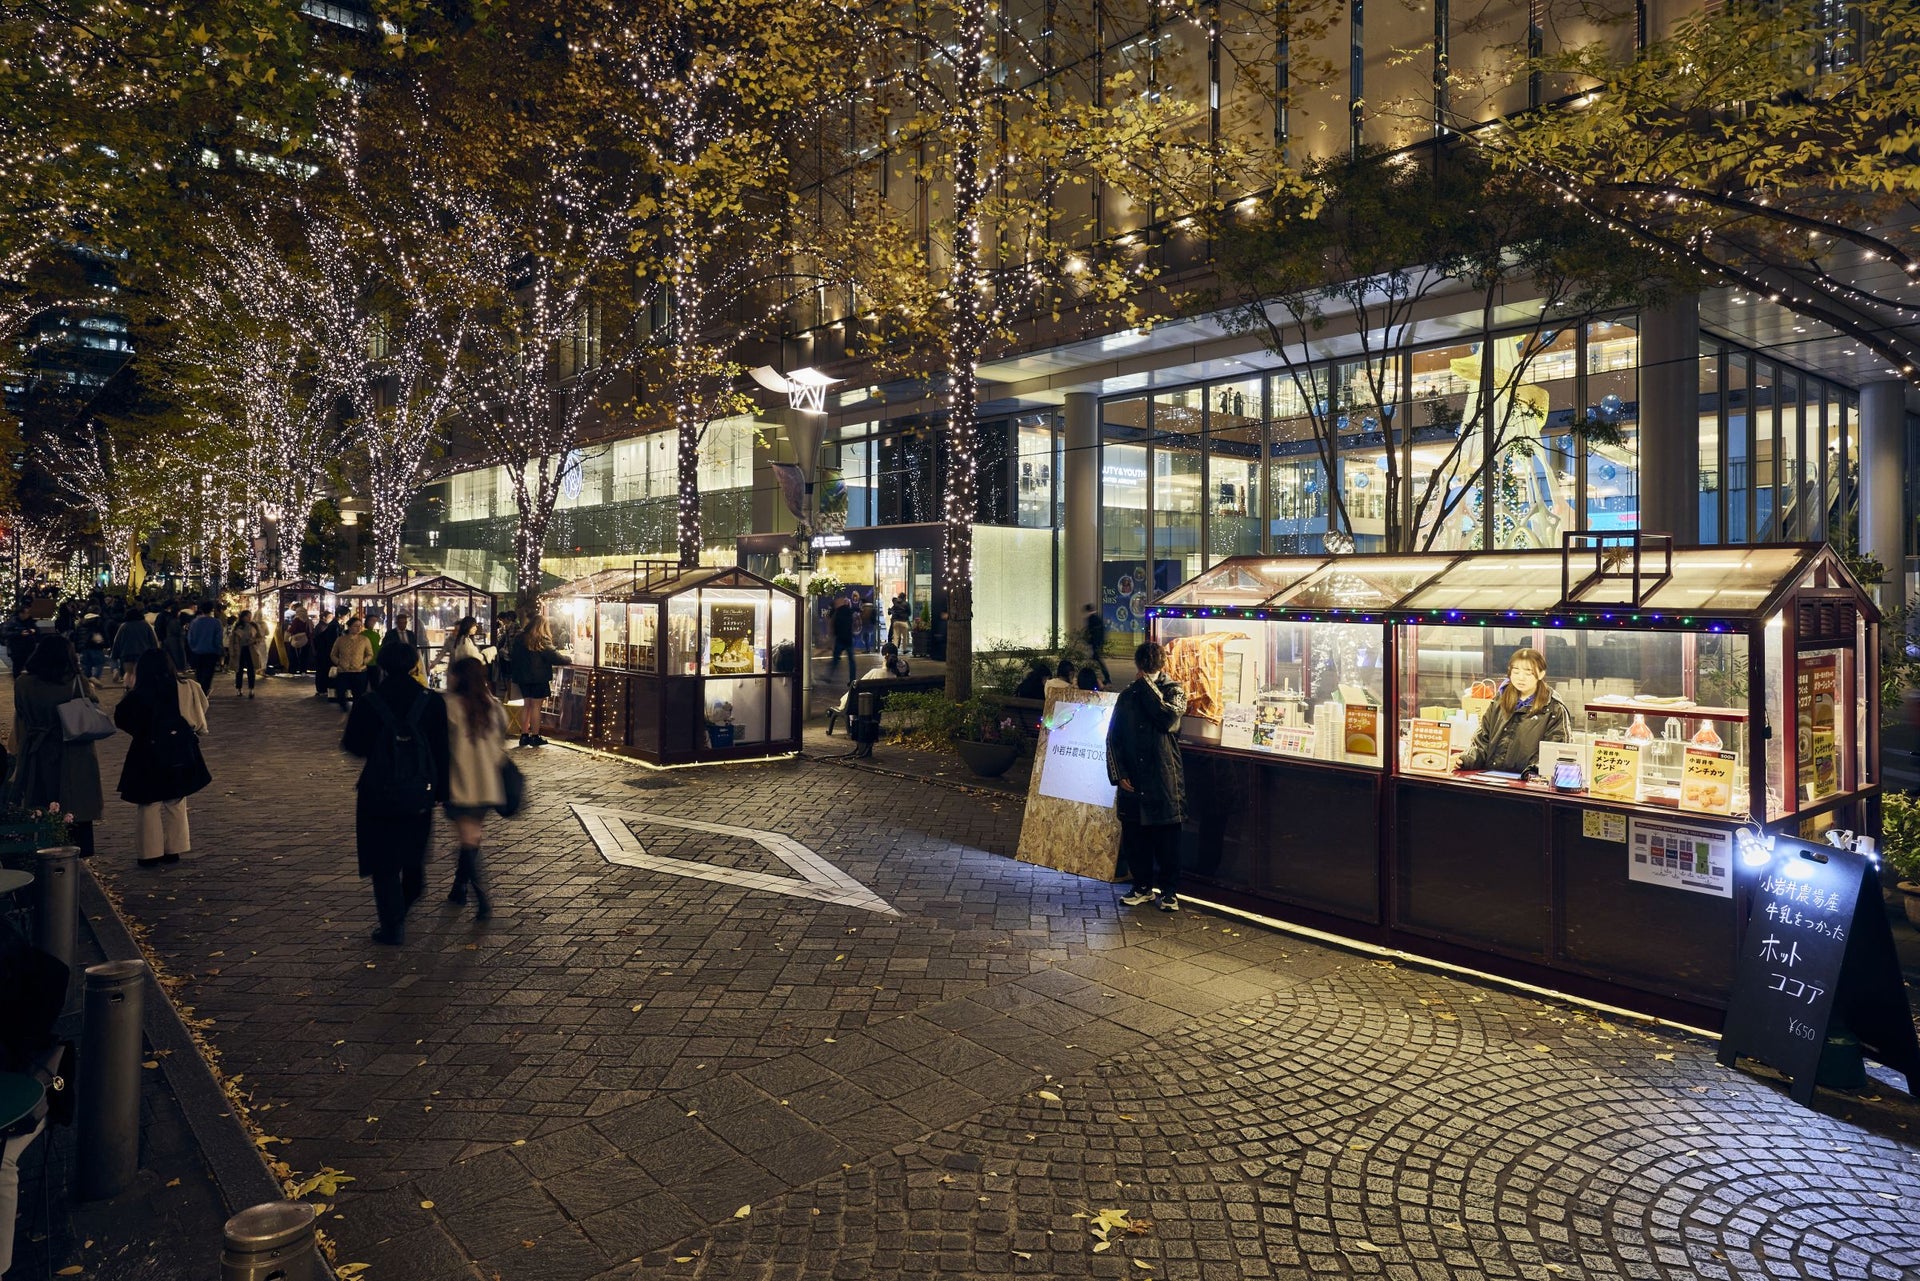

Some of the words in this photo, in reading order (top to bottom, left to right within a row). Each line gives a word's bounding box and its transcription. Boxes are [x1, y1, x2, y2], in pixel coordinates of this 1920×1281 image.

[1052, 743, 1107, 761] 小岩井農場TOK
[1596, 755, 1631, 766] メンチカツ
[1595, 762, 1616, 772] サンド
[1687, 765, 1726, 778] メンチカツ
[1761, 875, 1840, 912] 小岩井農場産
[1765, 901, 1845, 941] 牛乳をつかった
[1759, 933, 1802, 968] ホット
[1768, 973, 1825, 1005] ココア
[1788, 1017, 1816, 1041] ¥650
